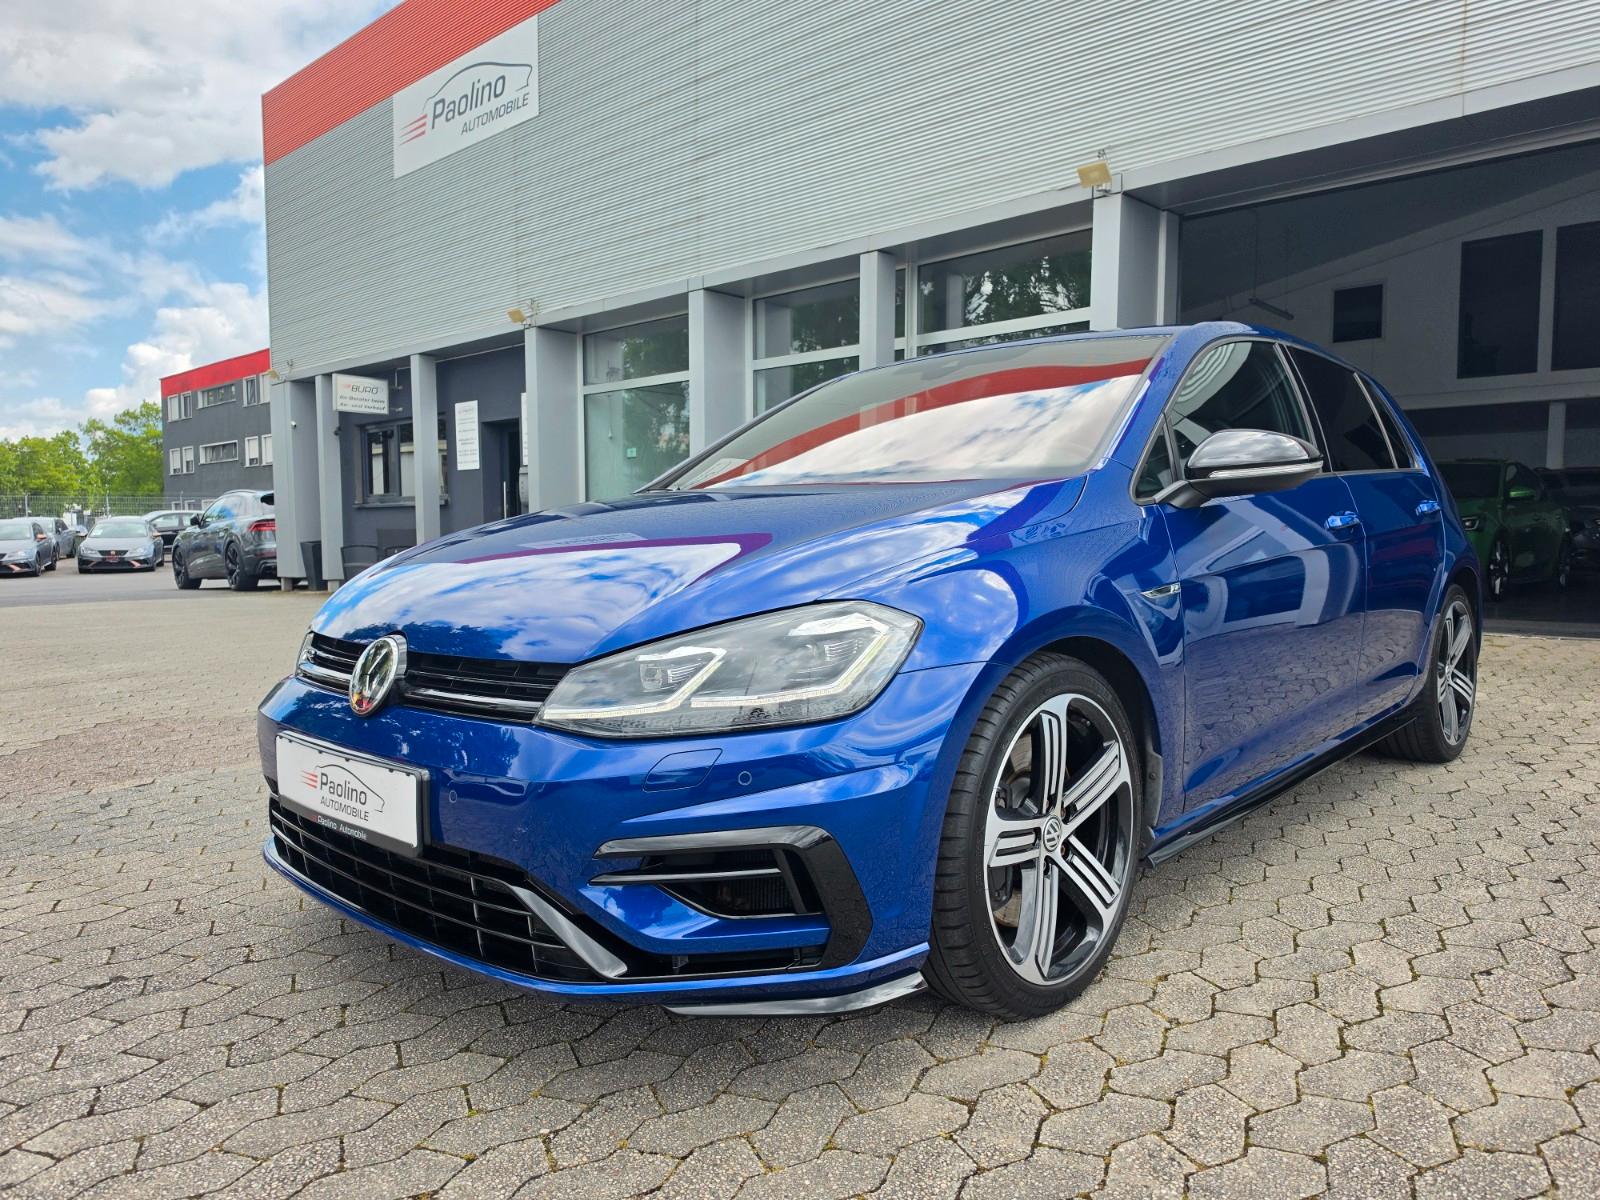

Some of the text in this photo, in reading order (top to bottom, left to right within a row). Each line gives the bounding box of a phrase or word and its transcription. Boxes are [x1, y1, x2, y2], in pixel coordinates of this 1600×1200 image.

[431, 75, 506, 130] Paolino
[460, 92, 530, 136] AUTOMOBILE
[320, 772, 367, 806] Paolino
[320, 795, 369, 822] AUTOMOBILE
[317, 815, 368, 841] Paolino Automobile
